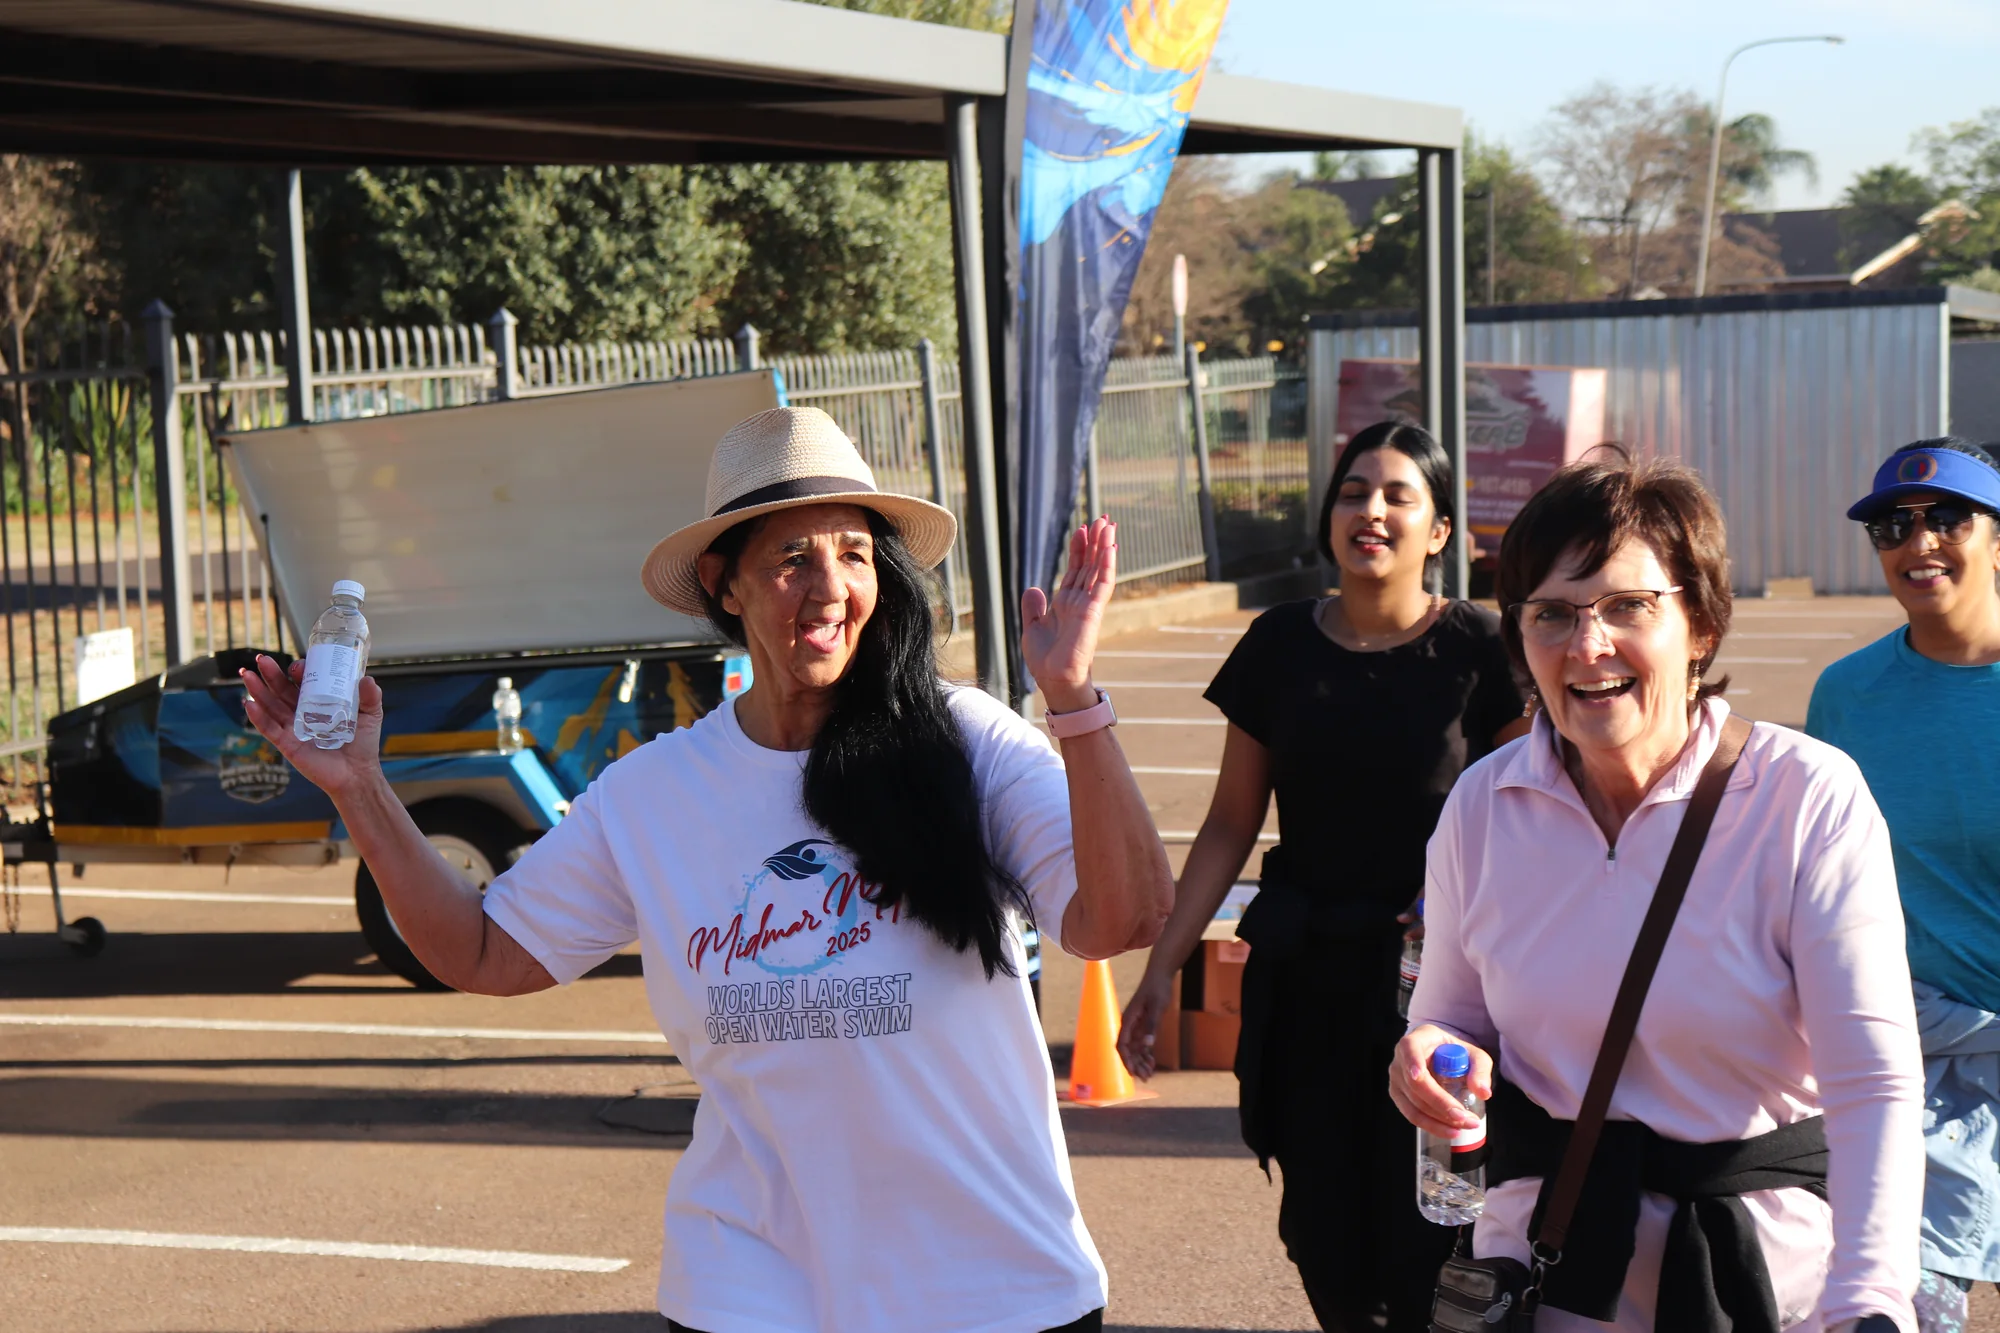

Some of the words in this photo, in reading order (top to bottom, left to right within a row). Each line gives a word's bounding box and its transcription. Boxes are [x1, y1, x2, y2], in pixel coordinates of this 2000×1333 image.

[687, 903, 822, 976] Midmar
[826, 921, 871, 957] 2025
[708, 979, 795, 1016] WORLDS
[800, 972, 912, 1010] LARGEST
[704, 1014, 759, 1045] OPEN
[760, 1010, 839, 1042] WATER
[843, 1004, 912, 1040] SWIM
